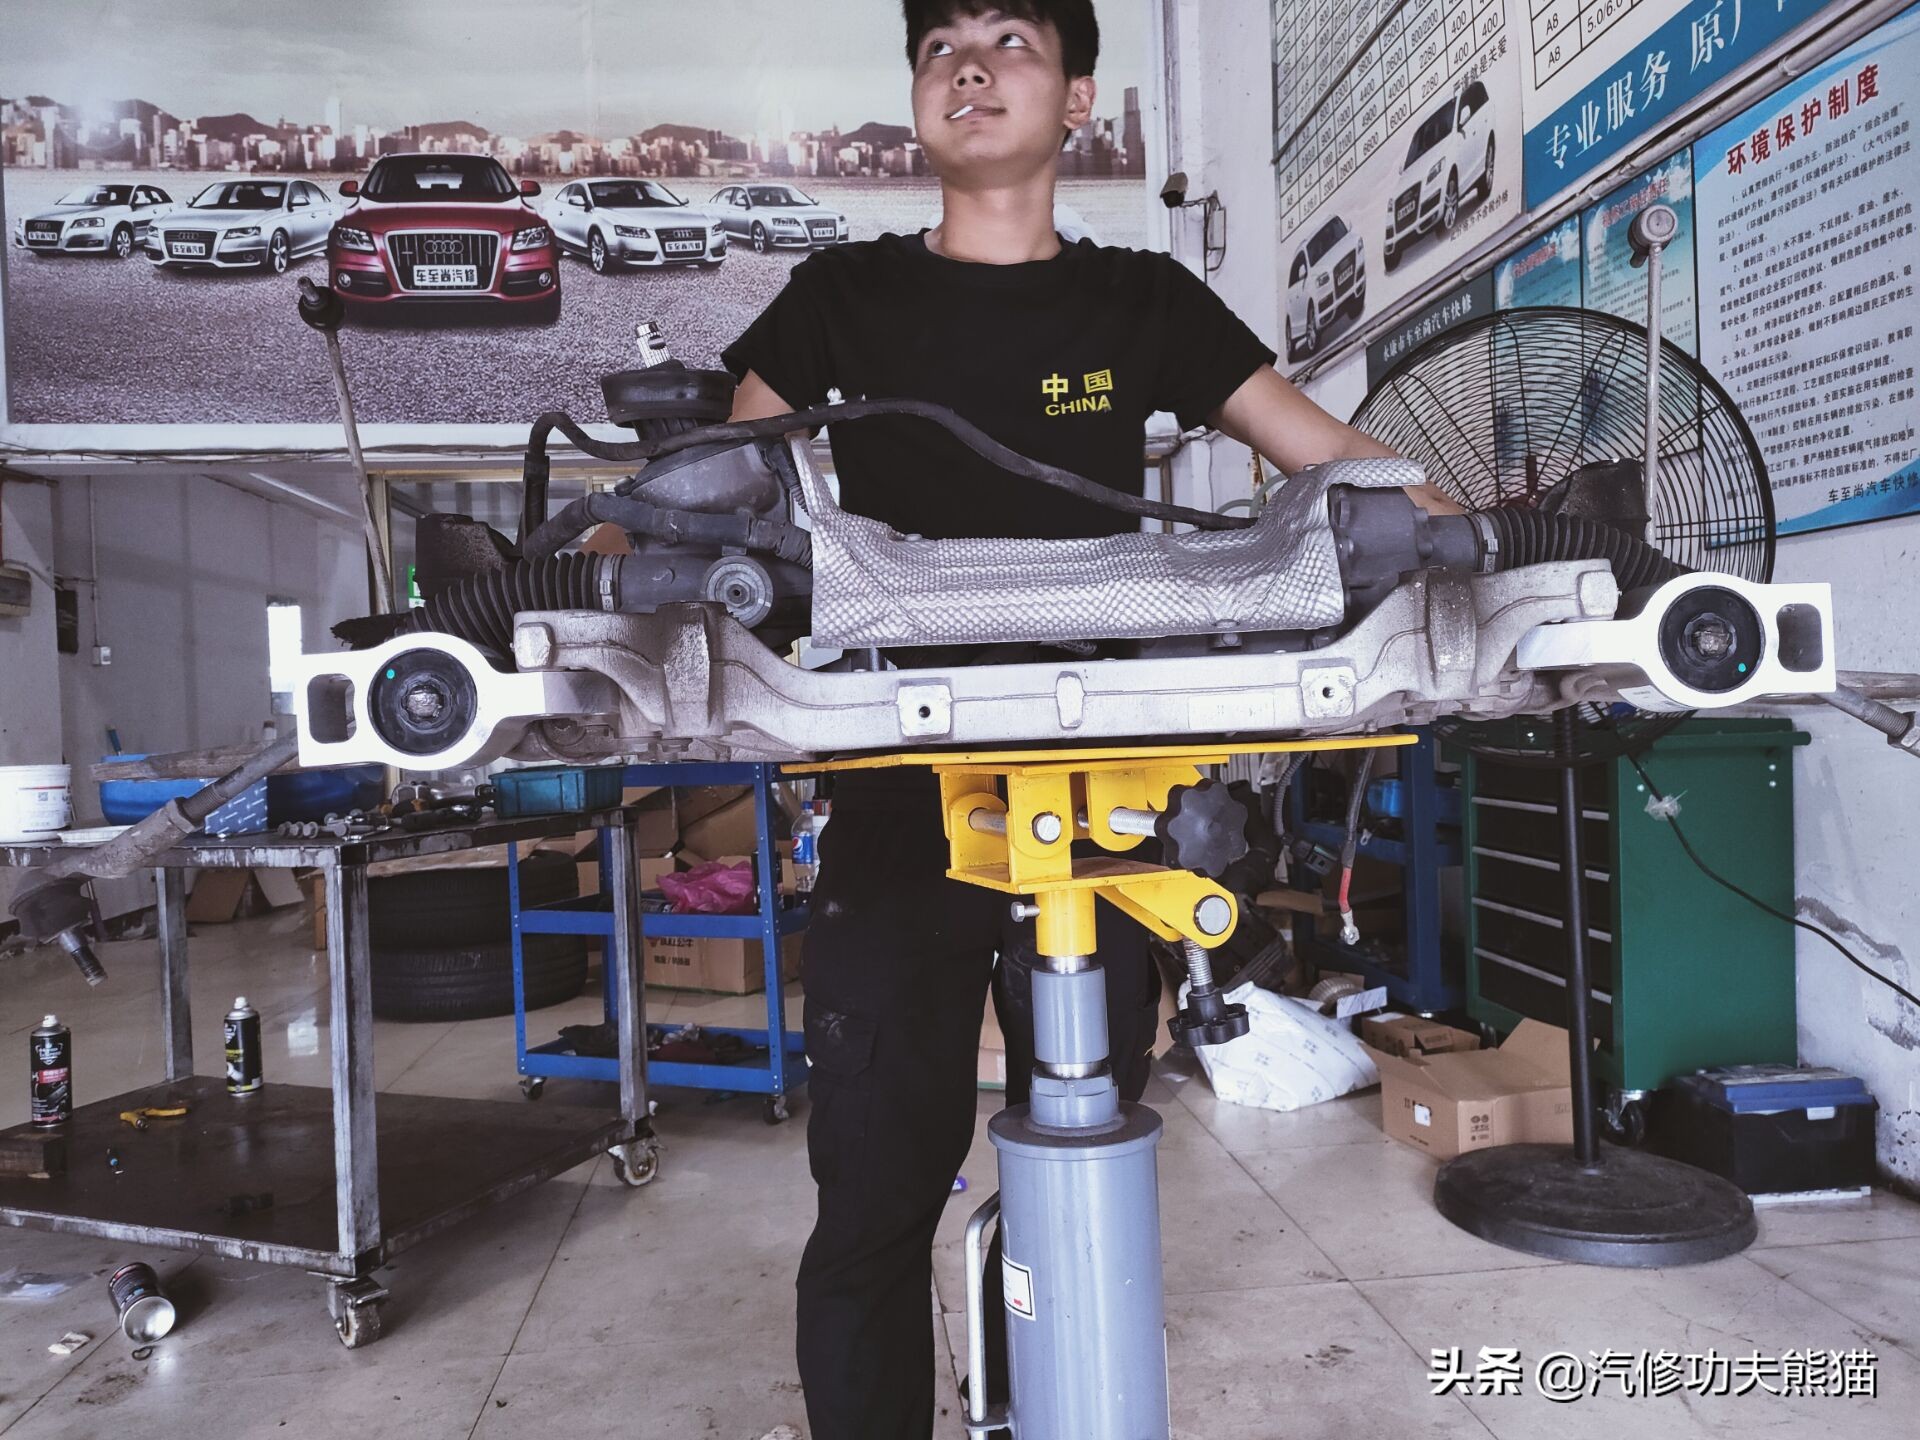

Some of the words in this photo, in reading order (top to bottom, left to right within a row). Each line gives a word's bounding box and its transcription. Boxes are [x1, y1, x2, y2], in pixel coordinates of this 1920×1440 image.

[1382, 19, 1400, 48] 2500
[1546, 13, 1560, 36] A8
[1388, 74, 1406, 99] 4000
[1419, 41, 1437, 69] 2280
[1451, 10, 1467, 34] 400
[1548, 46, 1561, 68] A8
[1390, 103, 1408, 130] 6000
[1421, 72, 1439, 99] 2280
[1453, 41, 1469, 66] 400
[1481, 12, 1498, 37] 400
[1360, 78, 1375, 102] 4400
[1546, 50, 1671, 169] 专业服务
[1727, 64, 1879, 175] 环境保护制度
[416, 268, 475, 283] 车至尚汽修
[1042, 368, 1113, 402] 中国
[1045, 394, 1112, 416] CHINA
[1828, 471, 1919, 504] 车至尚汽车快修
